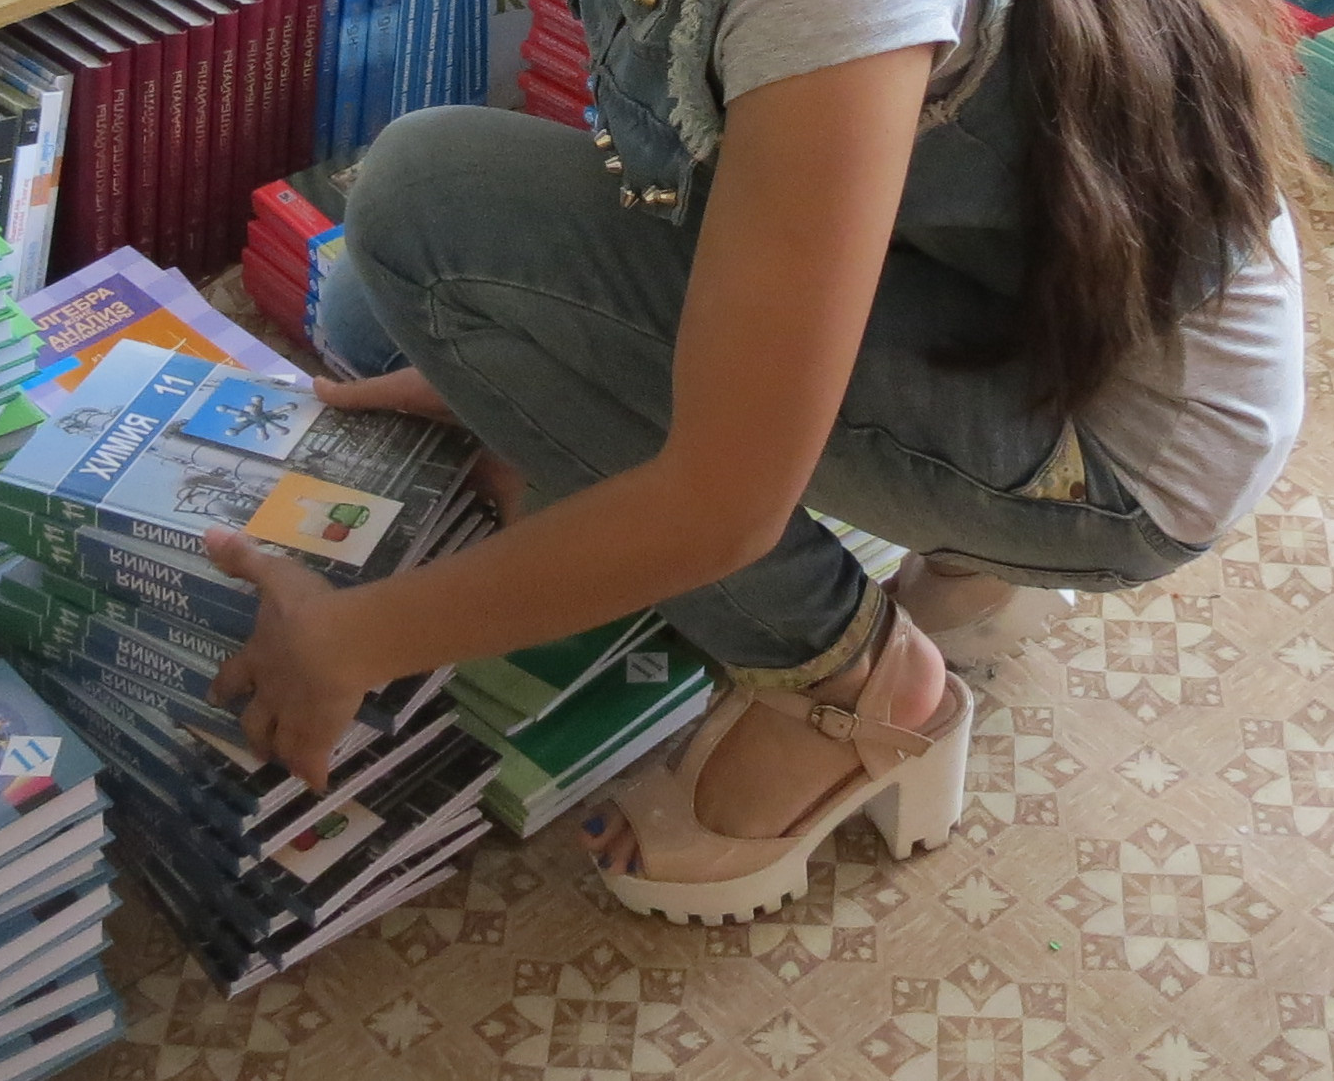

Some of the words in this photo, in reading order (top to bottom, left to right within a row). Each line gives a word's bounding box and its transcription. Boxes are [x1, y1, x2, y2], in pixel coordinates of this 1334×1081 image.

[37, 287, 115, 332] ЛГЕБРА
[48, 301, 130, 347] АНАЛИЗ
[79, 411, 160, 482] ХИМИЯ
[154, 374, 194, 396] 11
[109, 548, 184, 588] ХИМИЯ
[116, 570, 189, 610] ХИМИЯ
[168, 627, 233, 663] ИМИЯ
[8, 738, 51, 774] 11
